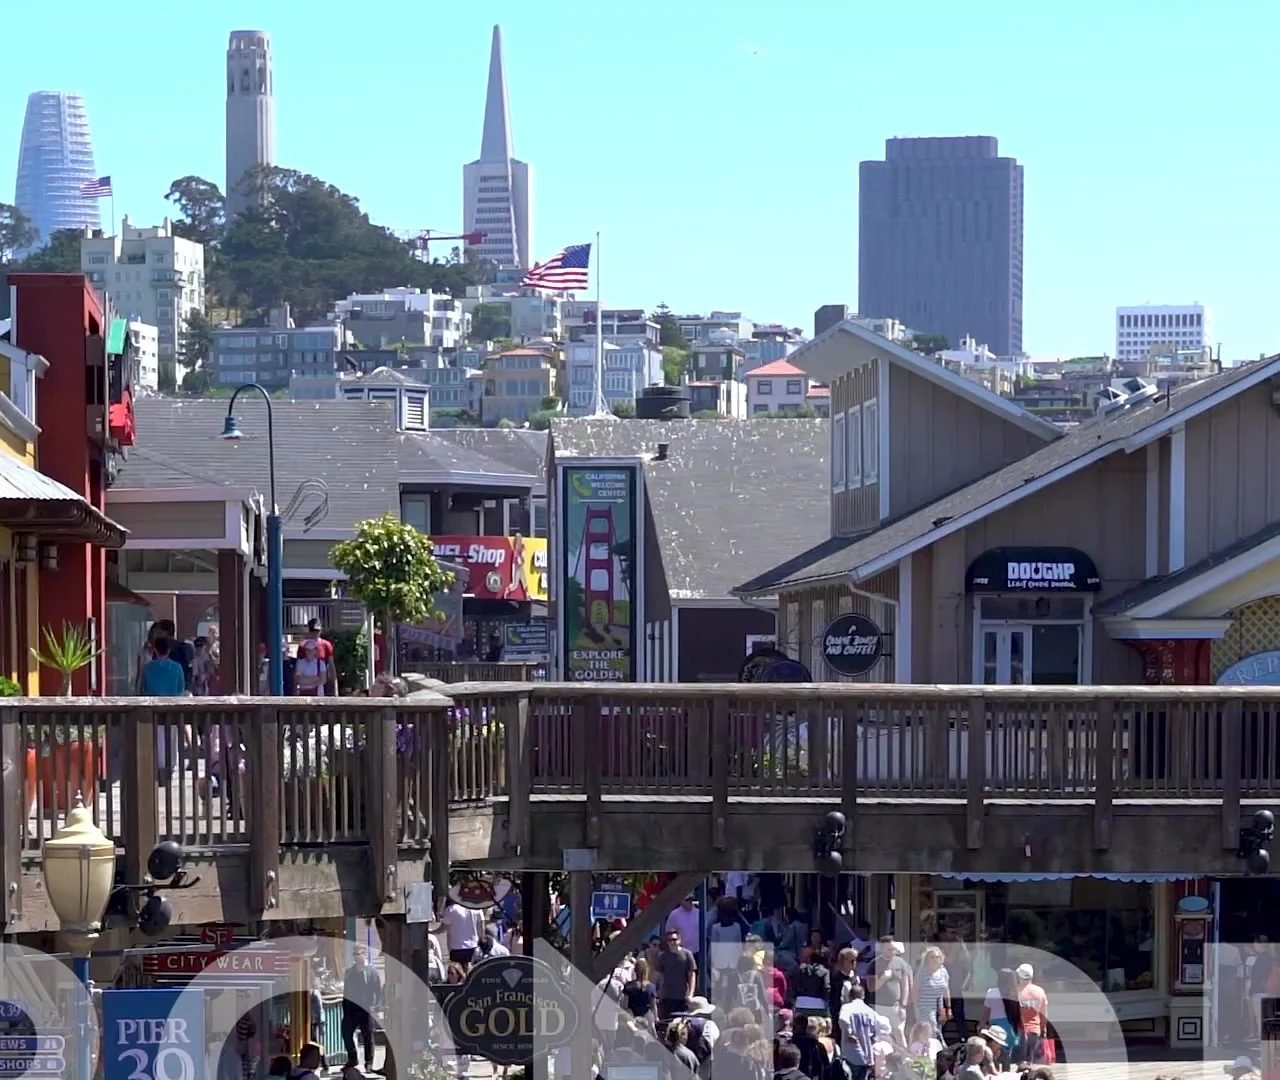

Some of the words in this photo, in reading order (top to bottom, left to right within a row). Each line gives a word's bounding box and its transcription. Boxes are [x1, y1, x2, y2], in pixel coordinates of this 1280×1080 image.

[467, 544, 506, 568] Shop
[1007, 562, 1075, 580] DOUGHP
[573, 650, 625, 660] EXPLORE
[588, 660, 610, 669] THE
[574, 670, 624, 680] GOLDEN
[204, 928, 228, 945] SF
[167, 956, 208, 969] CITY
[217, 956, 264, 970] WEAR
[467, 997, 492, 1009] San
[496, 989, 558, 1009] Francisco
[7, 1005, 21, 1017] 39
[460, 1007, 566, 1037] GOLD
[116, 1018, 191, 1045] PIER
[0, 1060, 41, 1070] SHOPS
